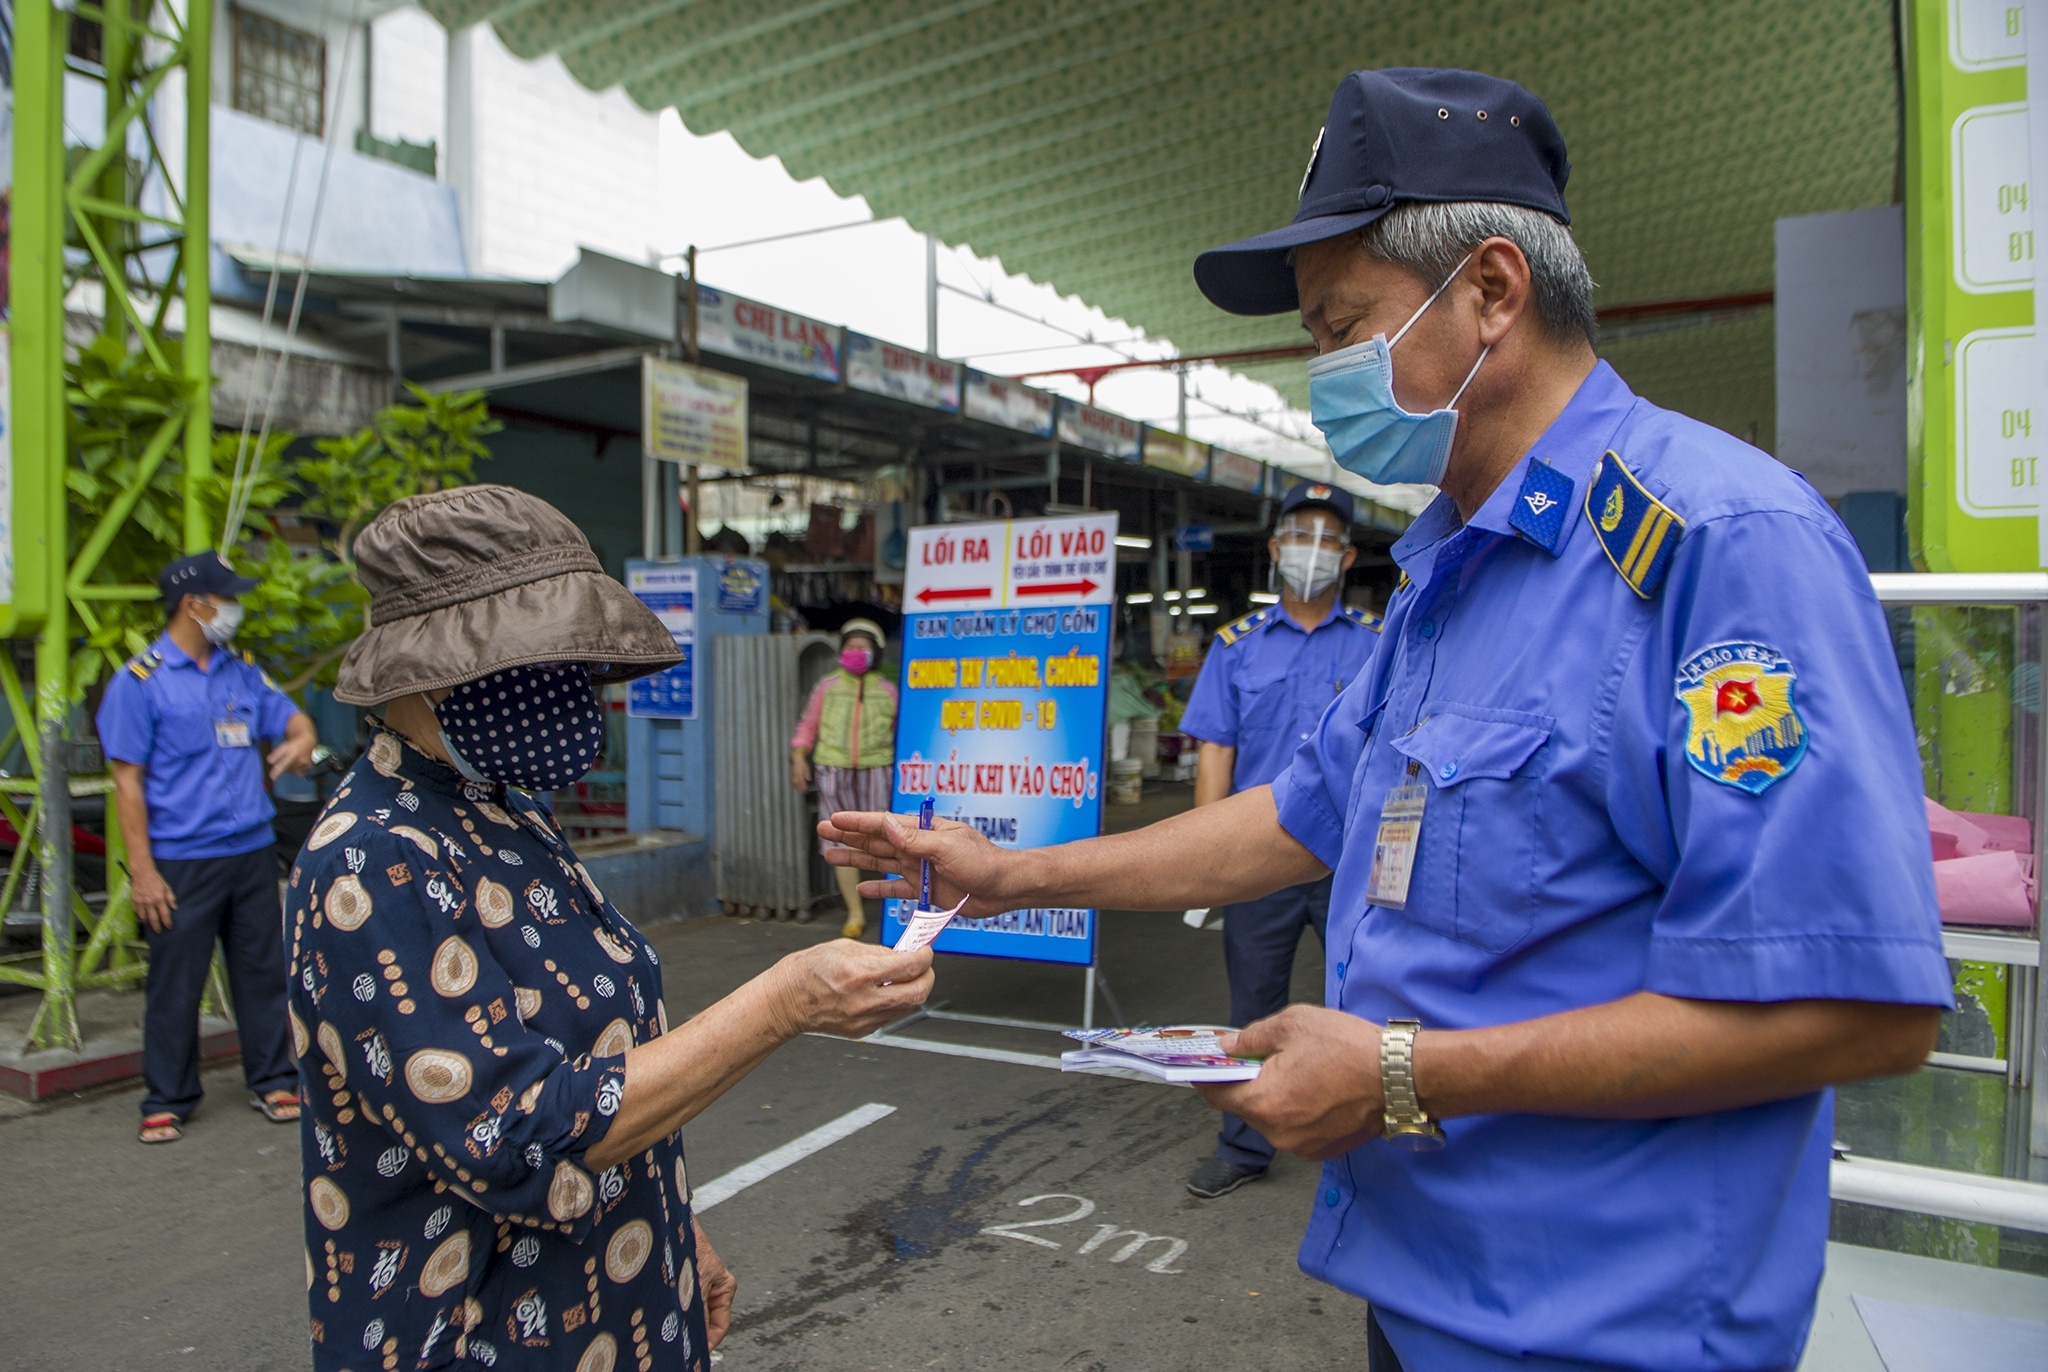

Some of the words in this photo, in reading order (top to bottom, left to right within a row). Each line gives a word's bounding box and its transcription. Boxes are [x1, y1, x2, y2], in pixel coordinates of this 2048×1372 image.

[2001, 407, 2033, 439] 04
[923, 531, 955, 566] LỐI
[962, 538, 990, 563] RA
[1017, 525, 1053, 560] LỐI
[1060, 523, 1105, 556] VÀO
[915, 618, 949, 639] BAN
[952, 610, 995, 640] QUẢN
[1023, 610, 1059, 639] CHỢ
[908, 658, 957, 689] CHUNG
[960, 658, 985, 689] TAY
[1045, 646, 1100, 687] CHỐNG
[941, 700, 977, 734] DỊCH
[979, 699, 1023, 730] COVID
[1037, 699, 1057, 730] 19
[898, 752, 933, 794] YÊU
[974, 763, 1005, 795] KHI
[1009, 756, 1045, 795] VÀO
[973, 815, 1018, 843] TRANG
[978, 1192, 1189, 1275] 2m
